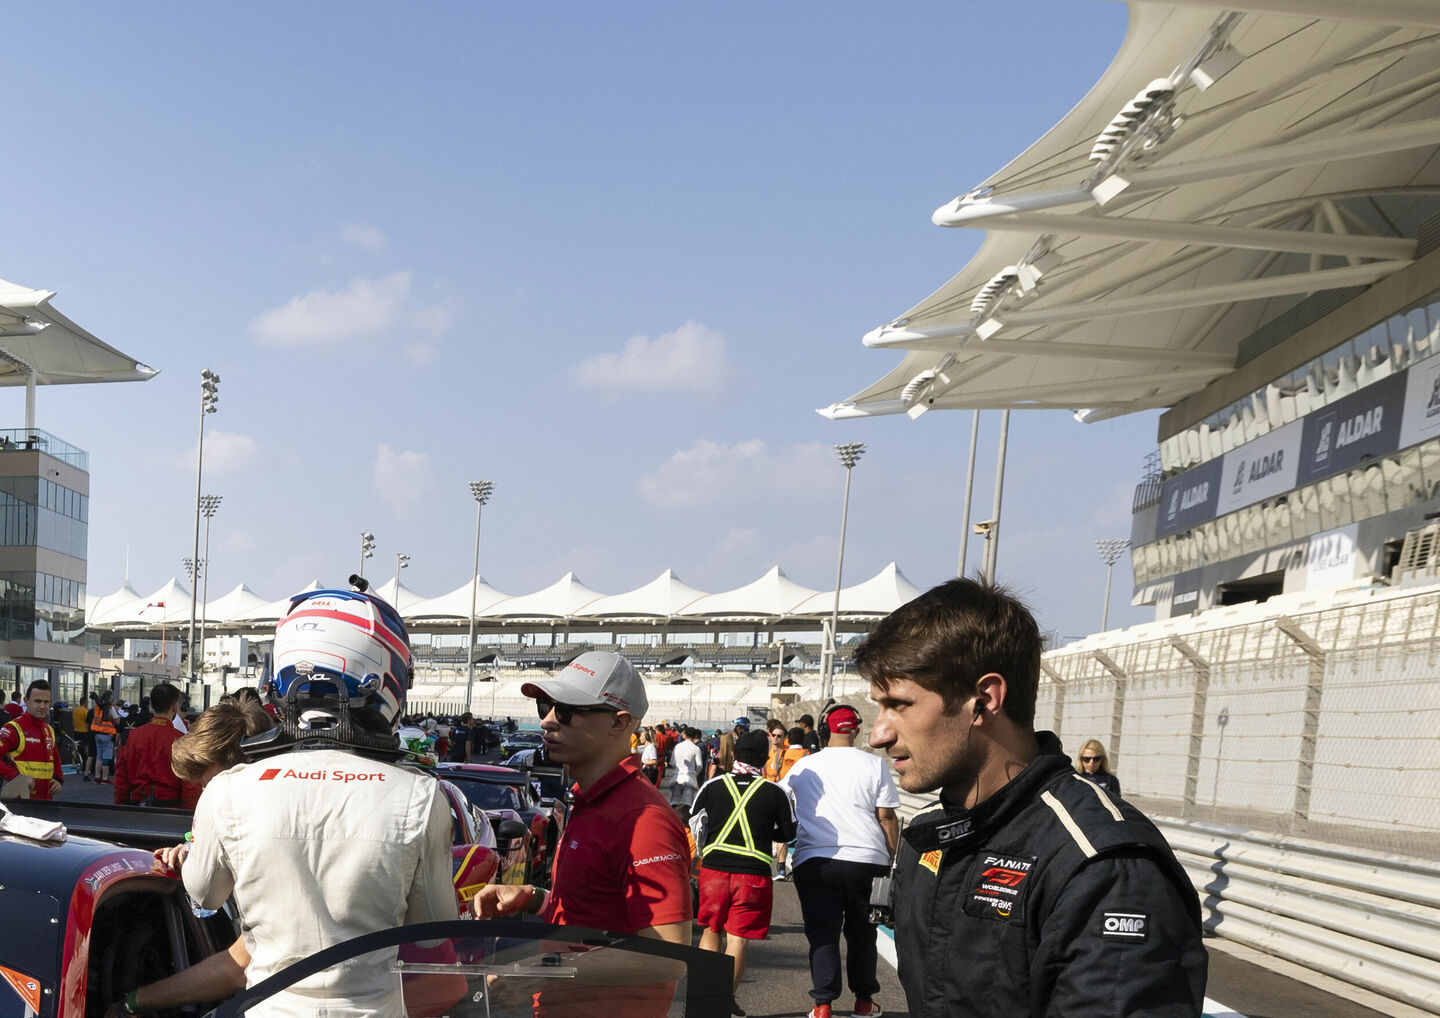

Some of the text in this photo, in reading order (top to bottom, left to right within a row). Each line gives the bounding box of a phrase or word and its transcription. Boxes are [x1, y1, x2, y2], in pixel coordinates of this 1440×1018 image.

[1335, 406, 1383, 449] ALDAR
[1248, 449, 1284, 484] ALDAR
[1180, 481, 1209, 512] ALDAR
[283, 769, 386, 783] Audi Sport
[937, 820, 972, 840] OMP
[1105, 919, 1144, 933] OMP
